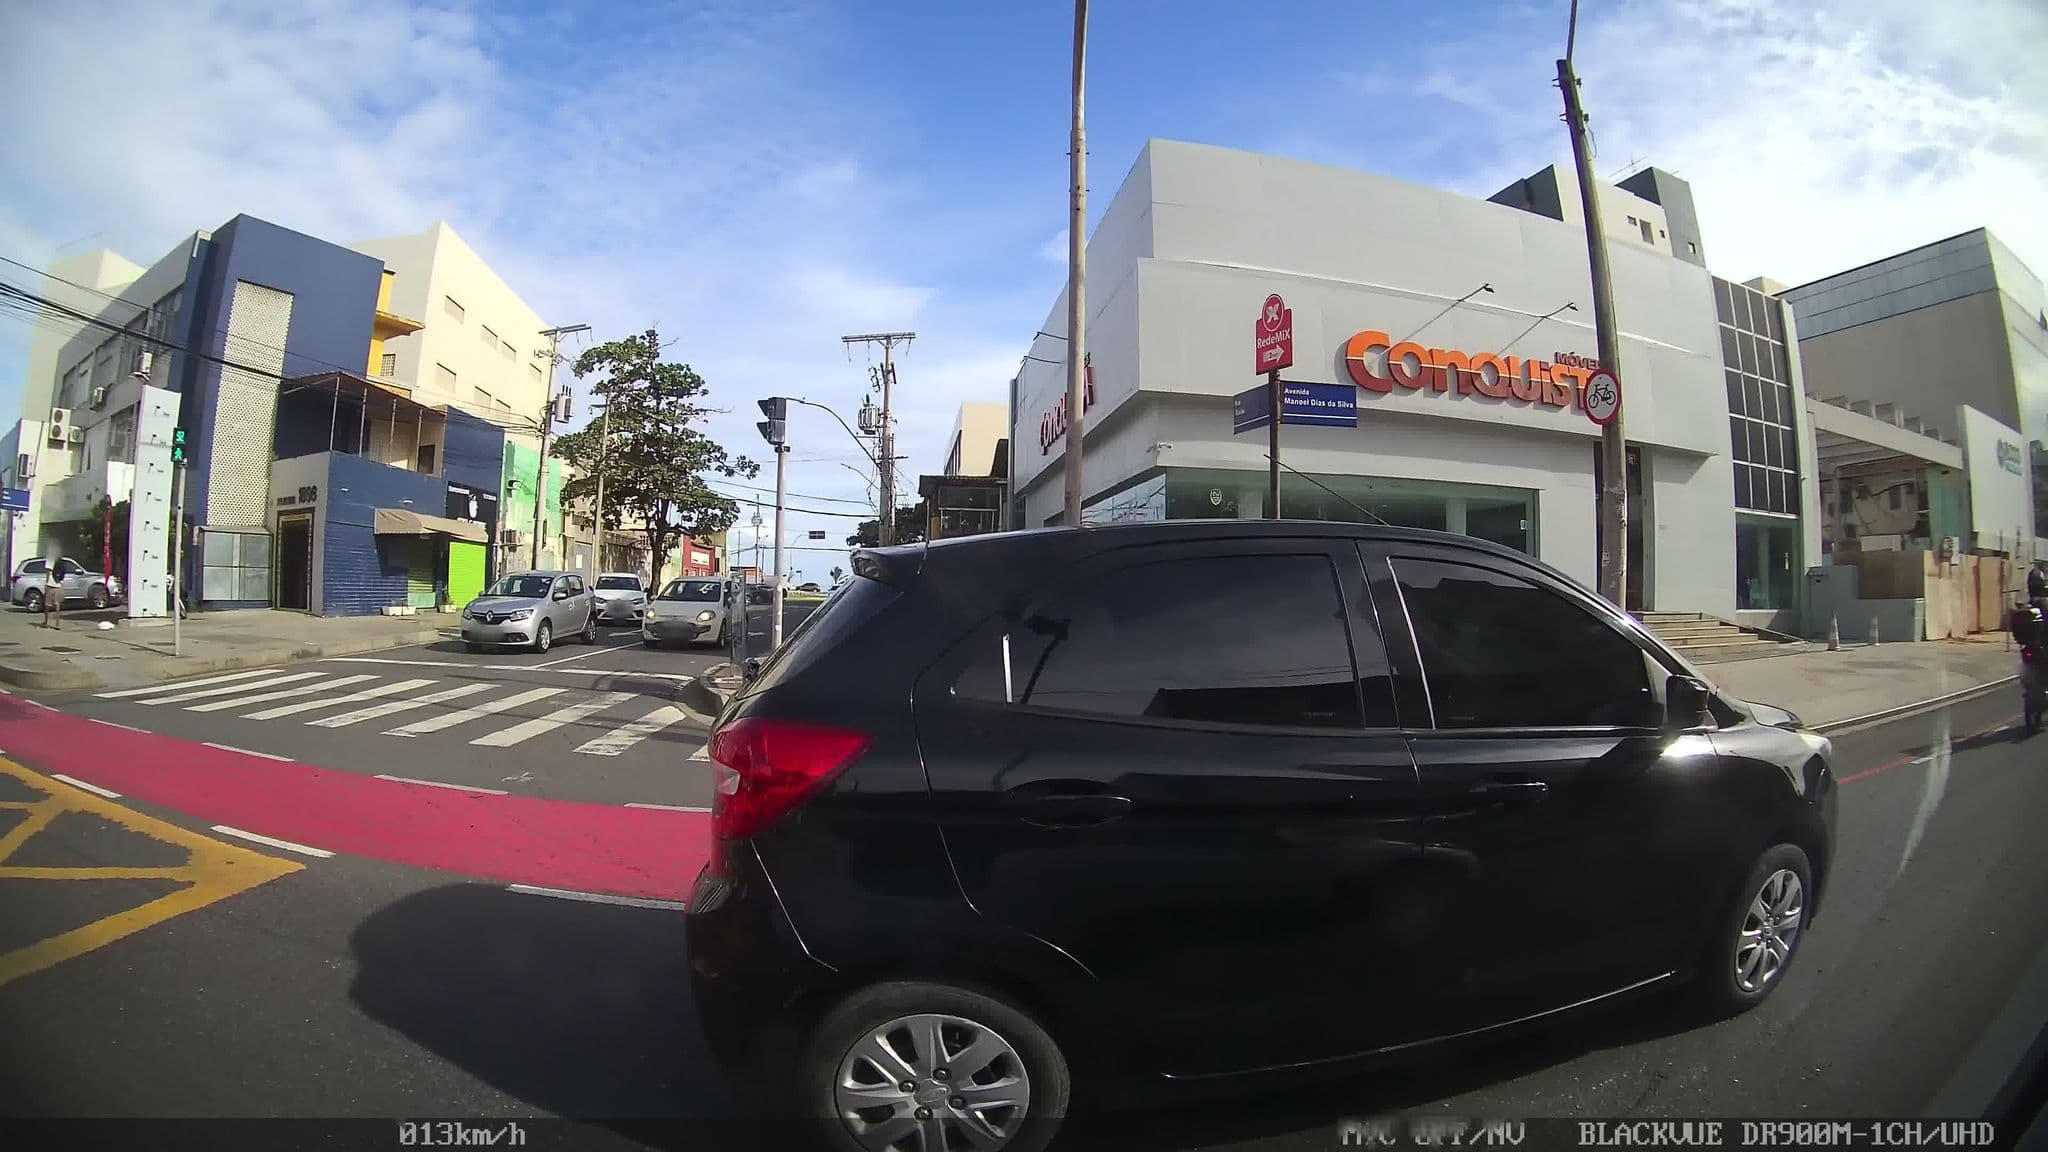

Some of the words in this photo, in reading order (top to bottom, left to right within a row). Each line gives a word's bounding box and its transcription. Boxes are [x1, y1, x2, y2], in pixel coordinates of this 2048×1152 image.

[1345, 330, 1592, 410] ConQUiST
[1283, 387, 1310, 396] Avenida
[1284, 397, 1310, 407] Manoel
[1310, 399, 1326, 407] Dias
[1327, 400, 1336, 408] da
[1337, 400, 1354, 409] Silva
